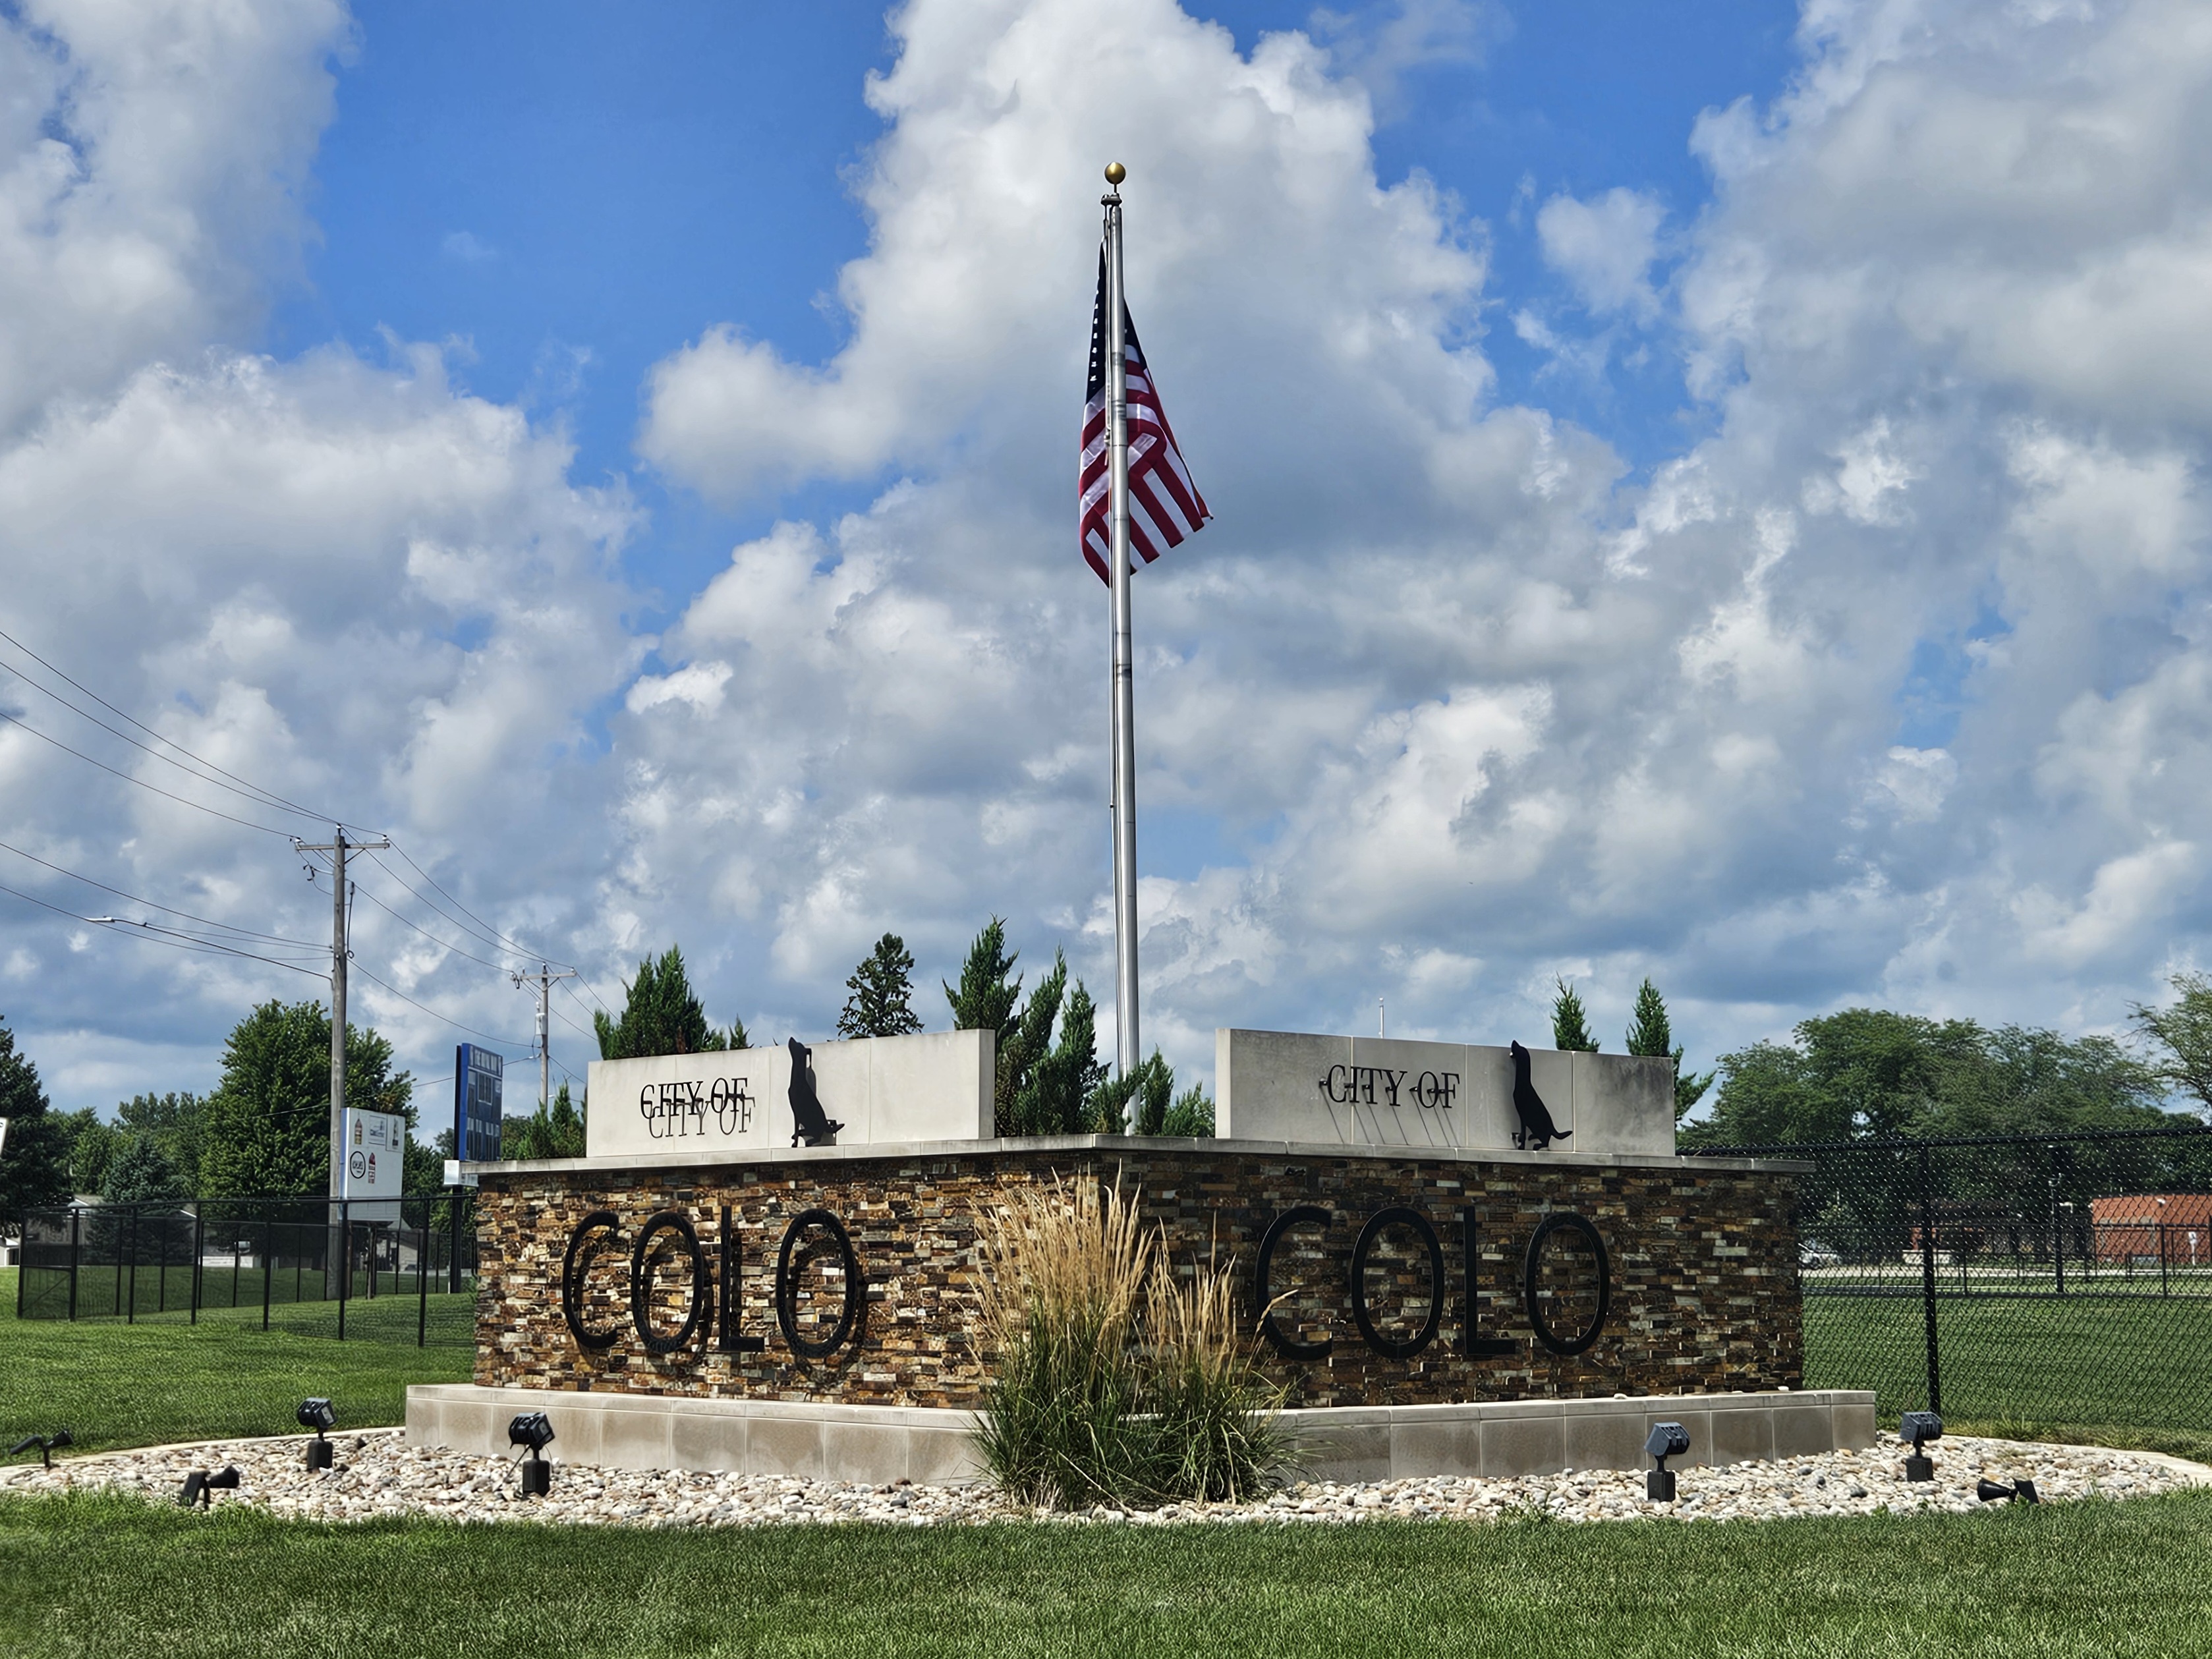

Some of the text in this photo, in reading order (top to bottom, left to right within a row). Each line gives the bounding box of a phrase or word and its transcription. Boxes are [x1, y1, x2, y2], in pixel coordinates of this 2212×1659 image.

[640, 1077, 748, 1119] CITY OF
[1327, 1065, 1460, 1109] CITY OF
[562, 1205, 857, 1359] COLO
[1255, 1205, 1610, 1361] COLO
